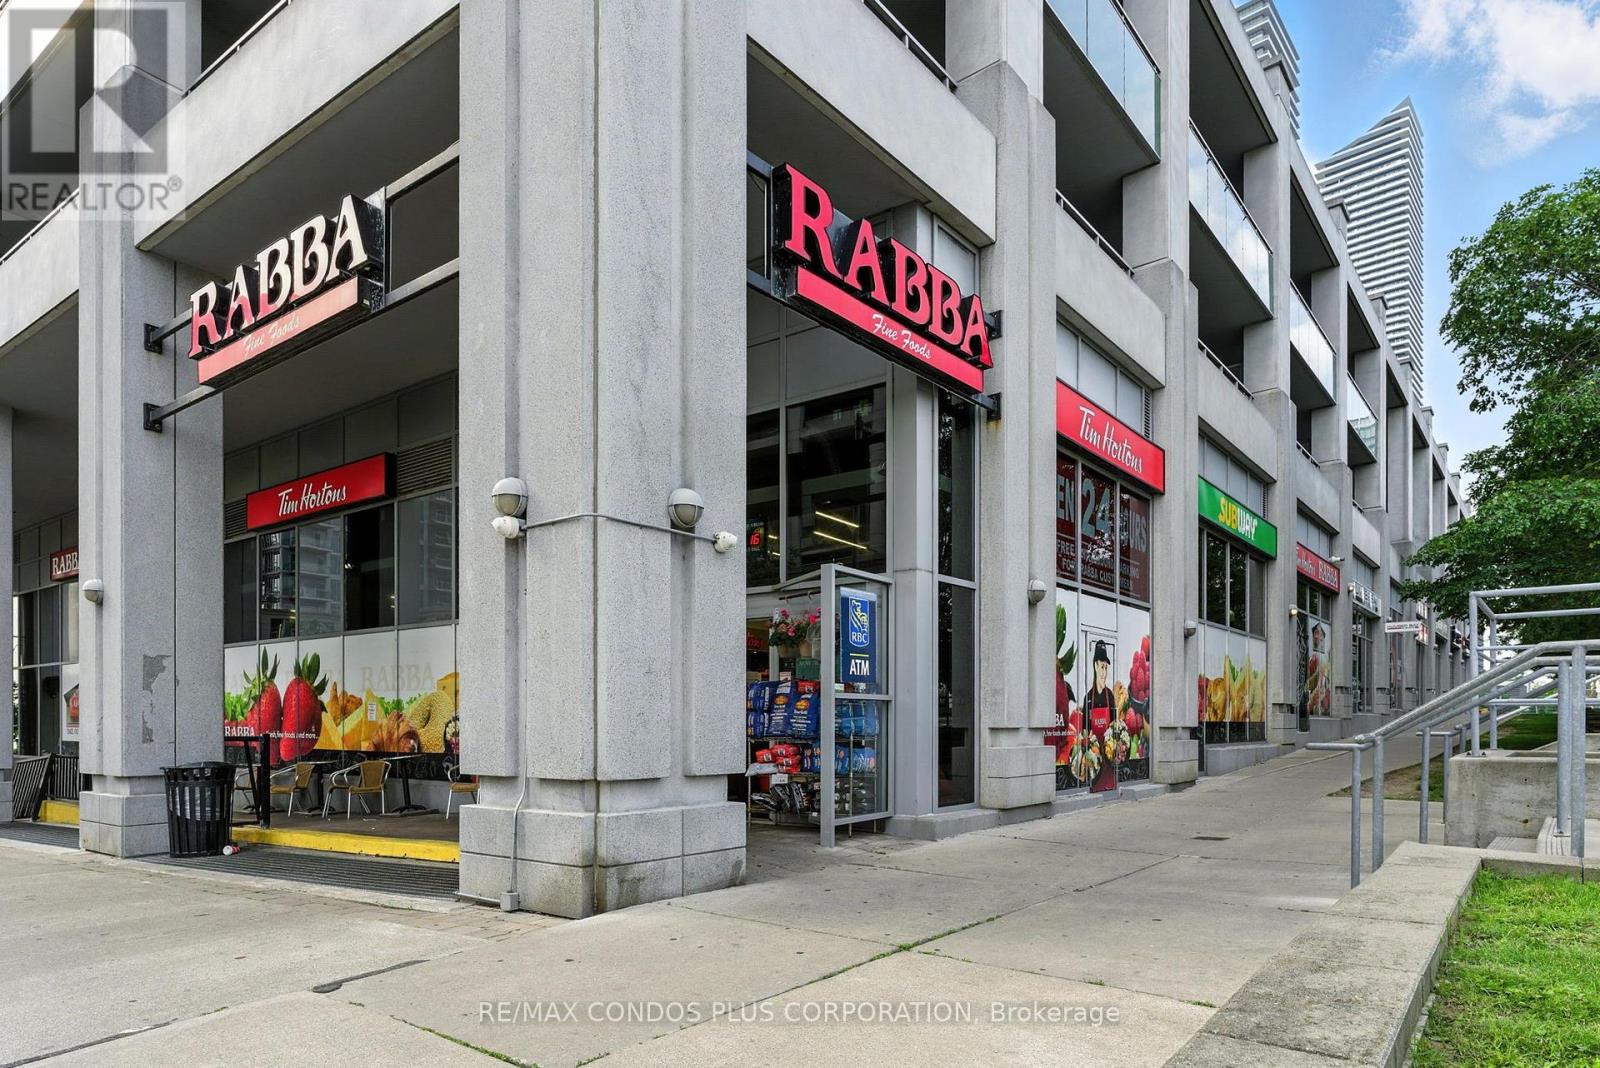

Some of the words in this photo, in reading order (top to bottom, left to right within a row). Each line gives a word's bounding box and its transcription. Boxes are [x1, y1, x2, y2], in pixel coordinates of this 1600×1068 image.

[188, 194, 367, 358] RABBA
[784, 163, 993, 367] RABBA
[872, 313, 898, 341] Fine
[901, 329, 932, 359] Foods
[1079, 406, 1101, 449] Tim
[1102, 421, 1143, 474] Hortons
[278, 488, 298, 516] Tim
[300, 481, 347, 511] Hortons
[1056, 474, 1075, 522] EN
[1081, 478, 1111, 538] 24
[1218, 496, 1258, 540] SUBWAY
[52, 552, 79, 575] RABB
[851, 632, 867, 643] RBC
[360, 663, 434, 693] RABBA
[849, 659, 870, 676] ATM
